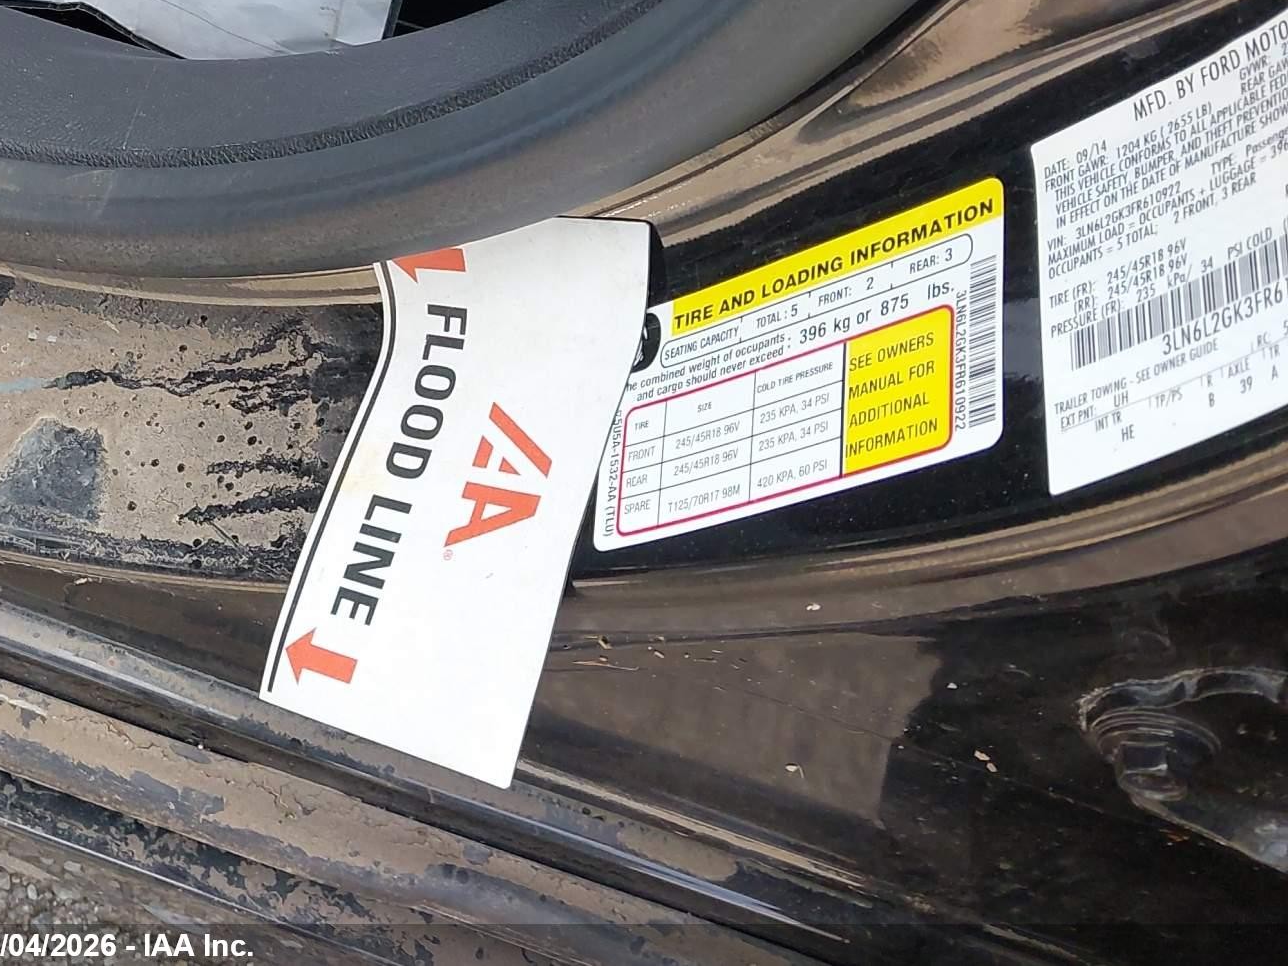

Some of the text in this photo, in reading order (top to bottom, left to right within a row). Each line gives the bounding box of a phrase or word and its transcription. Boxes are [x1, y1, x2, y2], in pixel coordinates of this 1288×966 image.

[1239, 54, 1271, 81] GVWR:
[1240, 71, 1265, 95] REAR
[1133, 89, 1172, 121] MFD.
[1176, 73, 1195, 101] BY
[1200, 49, 1241, 87] FORD
[1044, 139, 1107, 179] DATE: 09/14
[1045, 101, 1212, 193] FRONT GAWR: 1204 KG 2655 LB)
[1055, 84, 1267, 202] THIS VEHICLE CONFORMS TO ALL APPLICABLE
[1055, 188, 1093, 215] VEHICLE
[1181, 136, 1202, 157] AND
[1205, 119, 1233, 144] THEFT
[1056, 121, 1256, 230] IN EFFECT ON THE DATE OF MANUFACTURE
[1212, 153, 1237, 175] TYPE:
[1047, 239, 1096, 266] MAXIMUM
[1098, 224, 1125, 247] LOAD
[1139, 188, 1195, 226] OCCUPANTS
[1209, 156, 1256, 191] LUGGAGE
[1047, 181, 1181, 252] VIN: 3LN6L2GK3FR610922
[1048, 248, 1104, 279] OCCUPANTS
[1173, 210, 1180, 224] 2
[1222, 186, 1228, 200] 3
[1231, 171, 1256, 195] REAR
[674, 198, 993, 330] TIRE AND LOADING INFORMATION
[909, 247, 953, 275] REAR: 3
[1049, 238, 1187, 308] TIRE (FR): 245/45R18 96V
[818, 277, 874, 307] FRONT: 2
[1051, 310, 1098, 338] PRESSURE
[1101, 298, 1125, 321] (FR):
[1136, 286, 1156, 303] 235
[1201, 256, 1213, 274] 34
[1227, 242, 1243, 260] PSI
[1246, 227, 1272, 250] COLD
[1074, 253, 1188, 316] (RR): 245/45R18 96V
[791, 303, 798, 317] 5
[799, 281, 955, 344] 396 kg or 875 lbs.
[664, 326, 740, 361] SEATING CAPACITY
[849, 332, 934, 372] SEE OWNERS
[1269, 344, 1281, 359] TR
[636, 345, 784, 401] and cargo should never exceed
[640, 333, 785, 389] combined weight of occupants
[954, 290, 966, 431] 3LN6L2GK3FR610922
[1054, 338, 1219, 415] TRAILER TOWING SEE OWNER GUIDE
[1228, 357, 1250, 379] AXLE
[756, 363, 833, 394] COLD TIRE PRESSURE
[848, 360, 935, 400] MANUAL FOR
[1240, 376, 1253, 394] 39
[697, 402, 712, 413] SIZE
[760, 393, 830, 424] 235 KPA, 34 PSI
[849, 392, 929, 429] ADDITIONAL
[1061, 391, 1129, 429] EXT PNT: UH
[1155, 387, 1183, 409] TP/PS
[634, 420, 649, 431] TIRE
[675, 421, 740, 450] 245/45R18 96V
[758, 421, 829, 452] 235 KPA, 34 PSI
[845, 418, 938, 458] INFORMATION
[1095, 410, 1123, 433] INT TR
[1121, 424, 1136, 442] HE
[330, 303, 468, 626] FLOOD LINE
[628, 446, 656, 462] FRONT
[674, 449, 739, 476] 245/45R18 96V
[626, 474, 648, 488] REAR
[757, 458, 828, 488] 420 KPA, 60 PSI
[624, 499, 651, 515] SPARE
[668, 485, 740, 513] T125/70R17 98M
[603, 506, 616, 537] (TLU)
